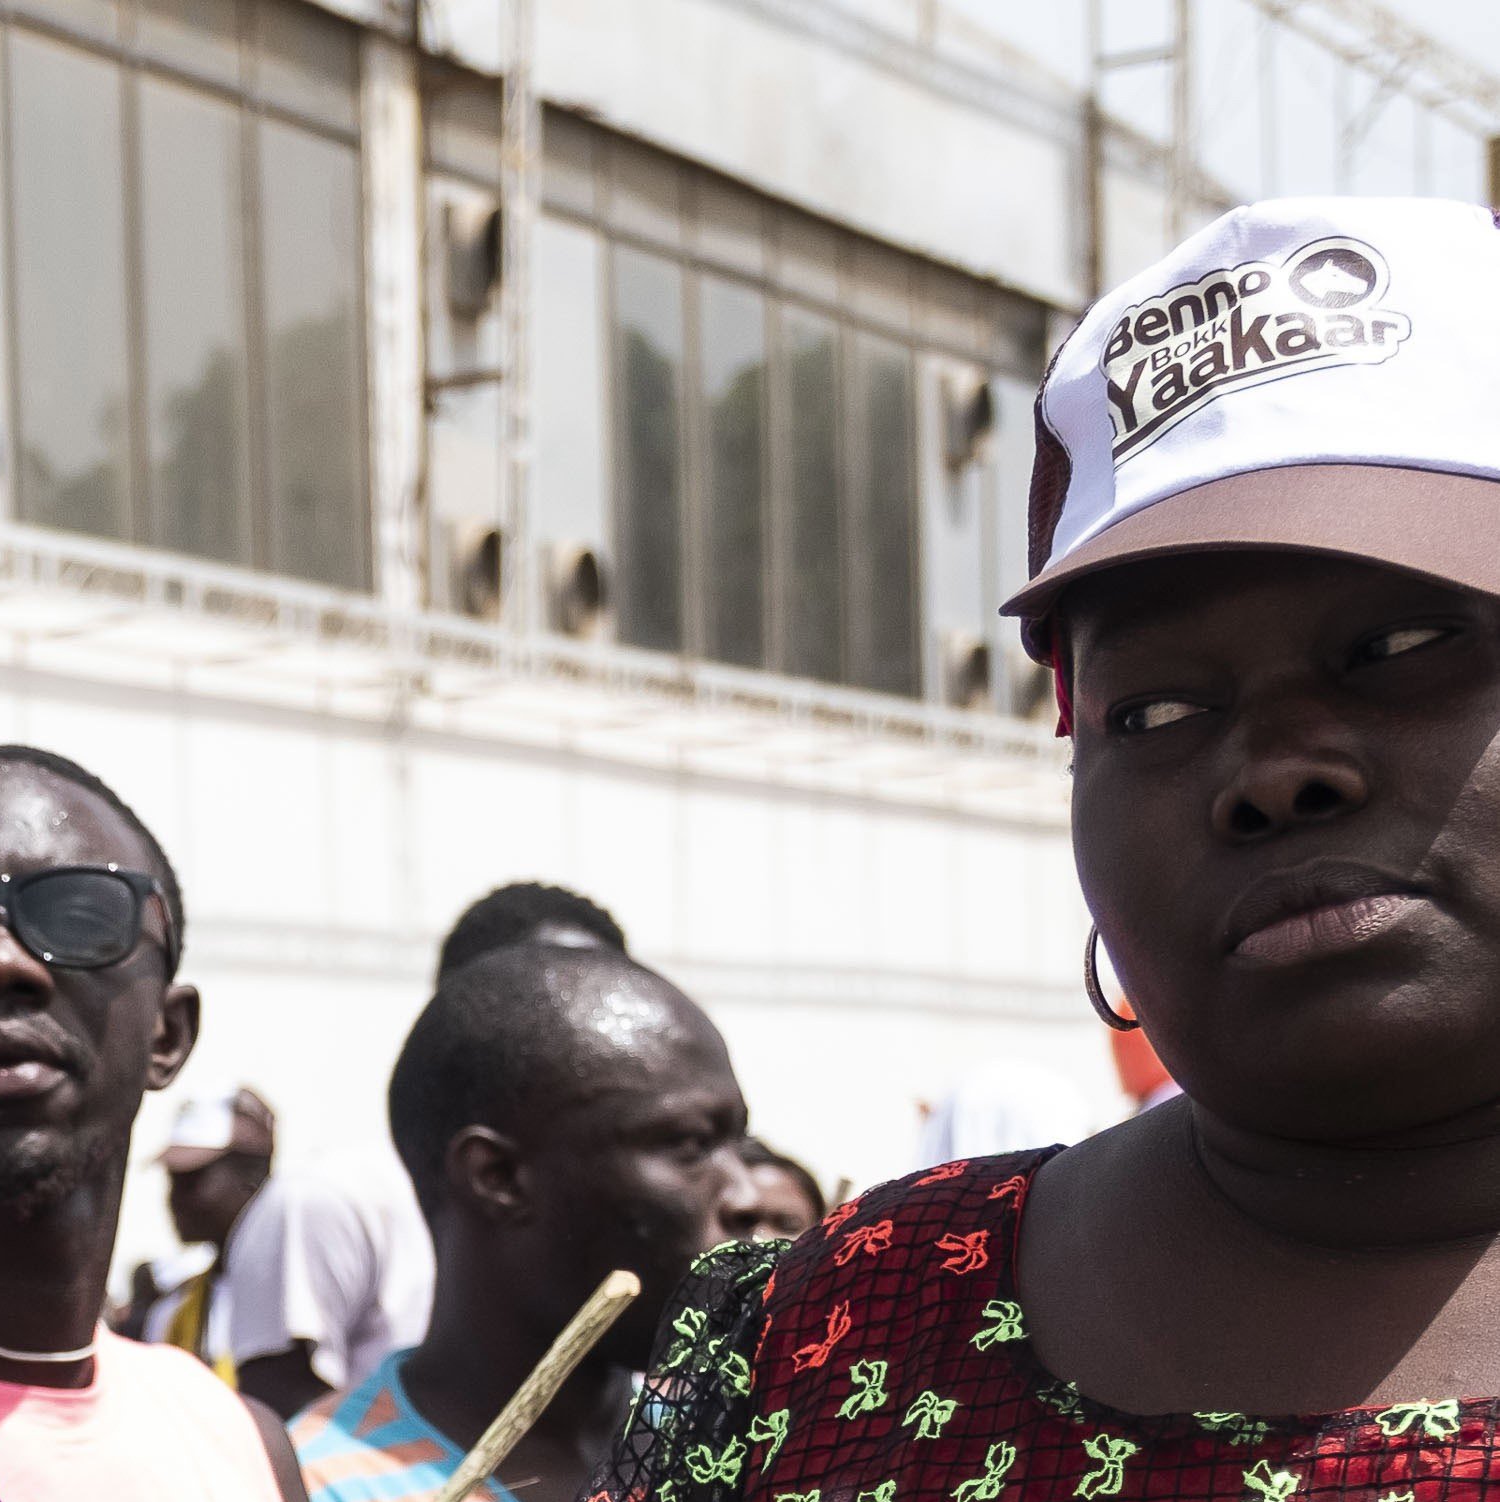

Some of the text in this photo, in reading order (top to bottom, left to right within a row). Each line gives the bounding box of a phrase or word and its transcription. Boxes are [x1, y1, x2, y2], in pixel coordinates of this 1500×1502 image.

[1104, 269, 1272, 367] Benno
[1150, 313, 1230, 372] Bokk
[1106, 304, 1399, 435] Yaakaar
